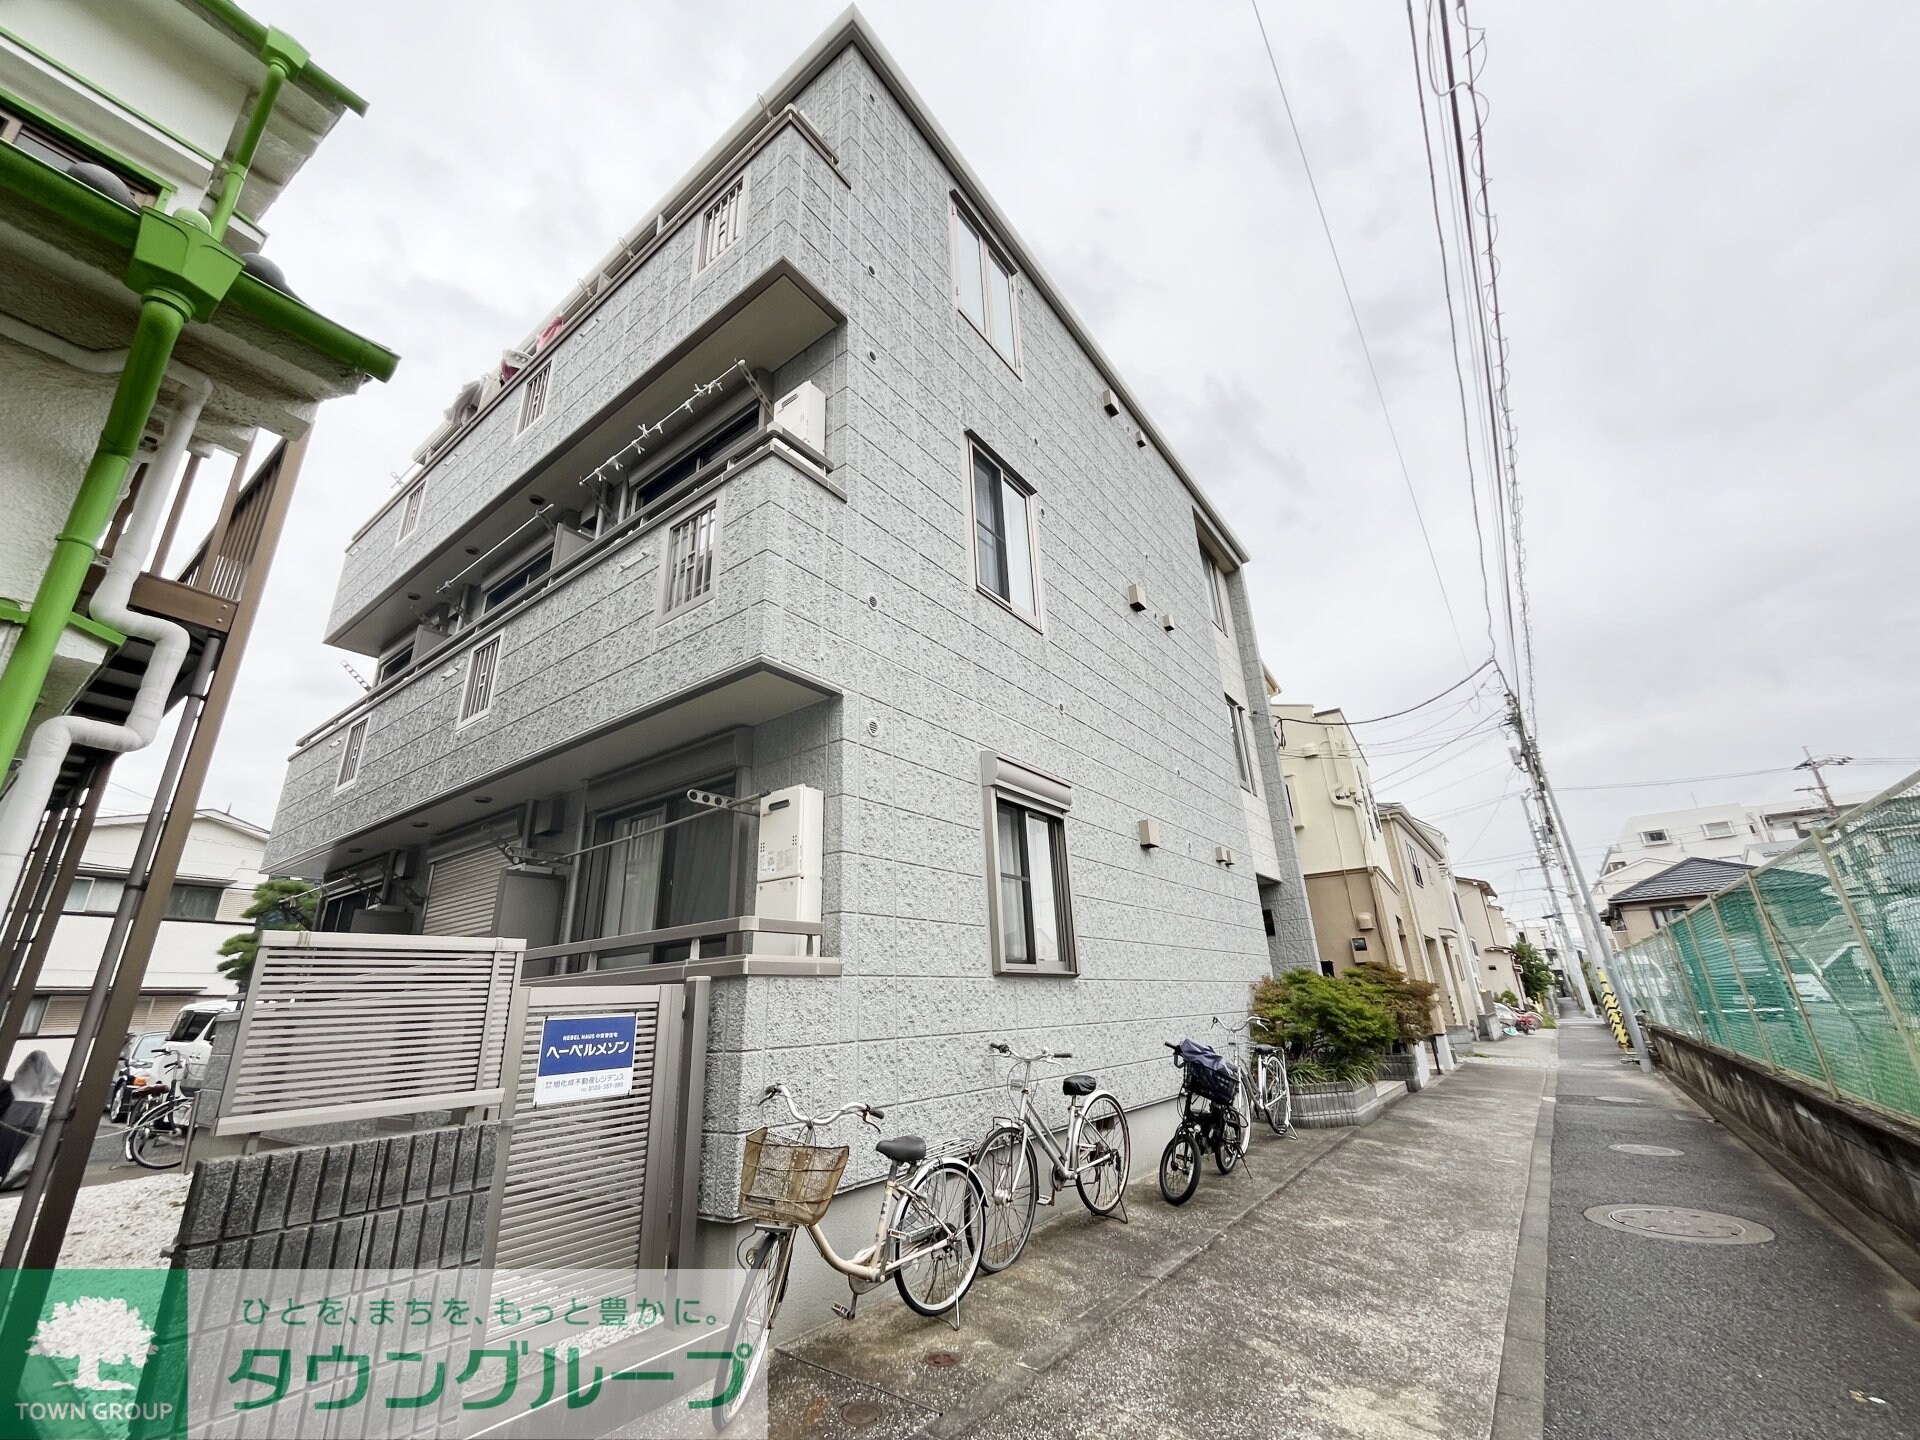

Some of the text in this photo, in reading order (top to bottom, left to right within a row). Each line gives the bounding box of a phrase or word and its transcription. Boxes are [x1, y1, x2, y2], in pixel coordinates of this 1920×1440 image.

[546, 1041, 630, 1059] ヘーベルメゾン
